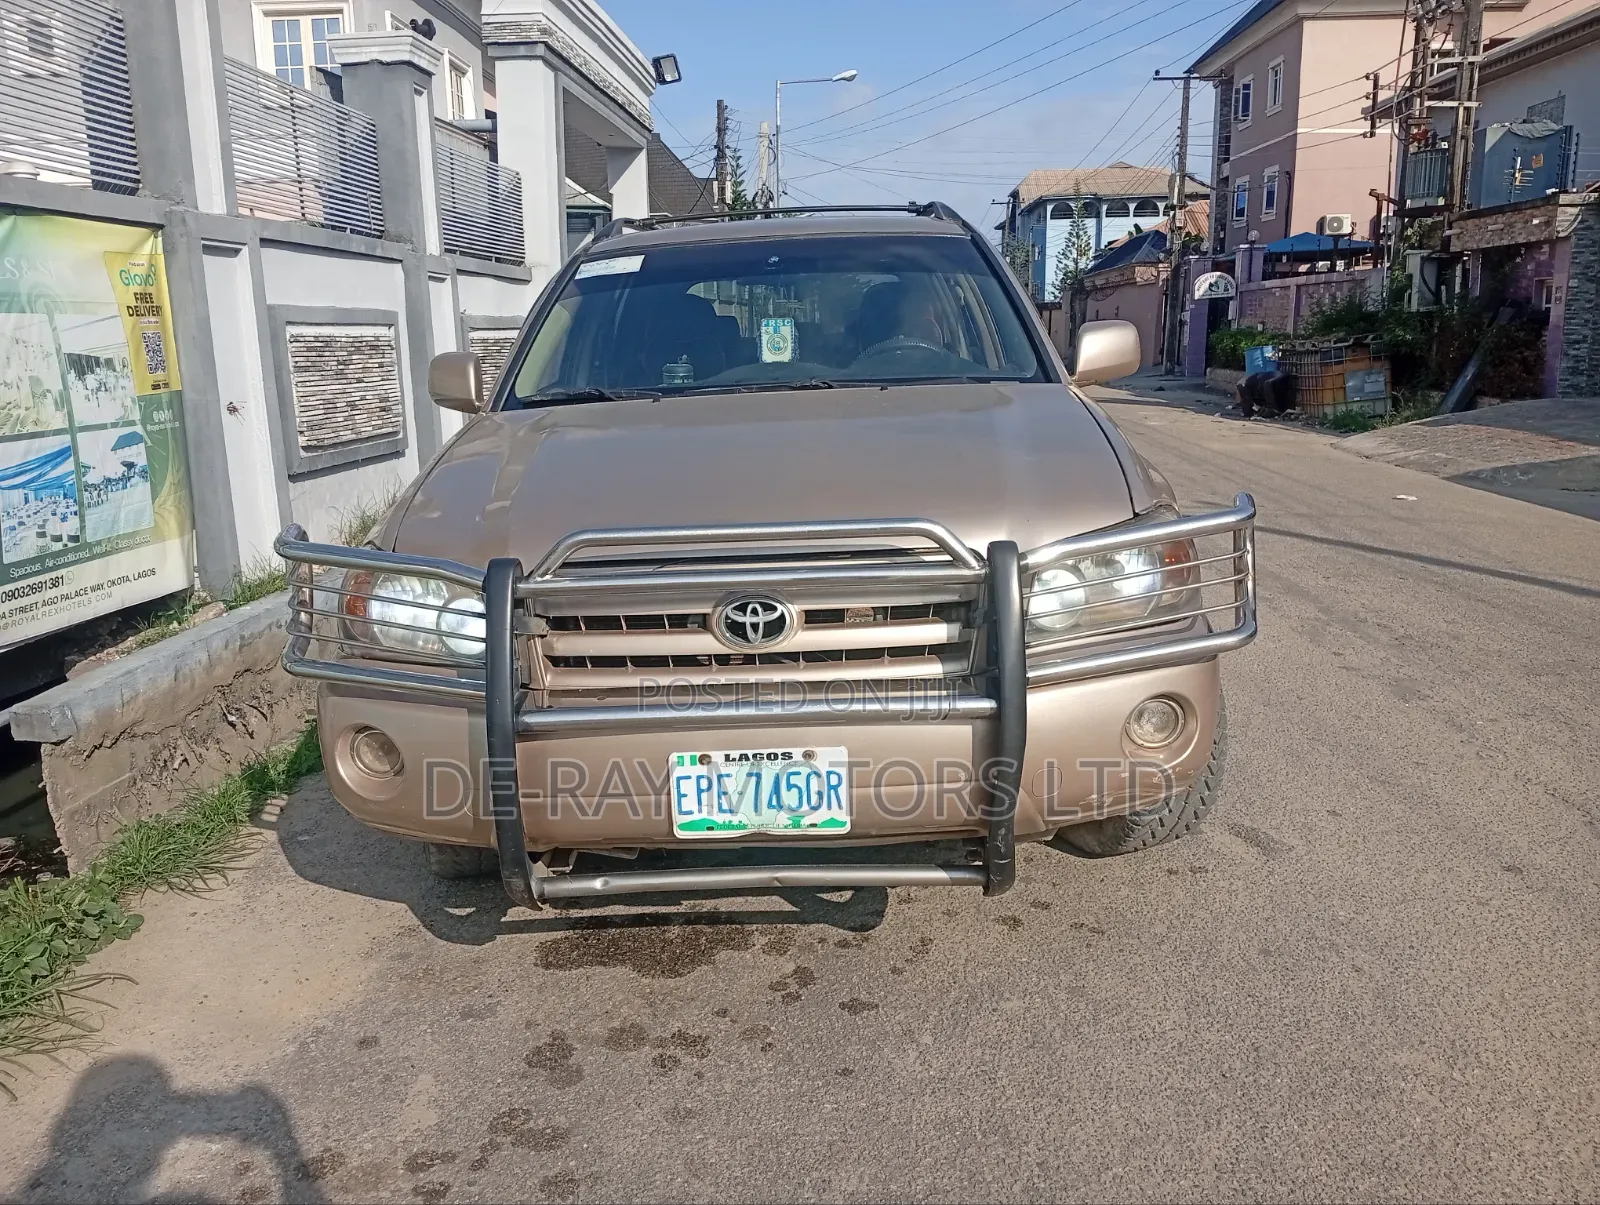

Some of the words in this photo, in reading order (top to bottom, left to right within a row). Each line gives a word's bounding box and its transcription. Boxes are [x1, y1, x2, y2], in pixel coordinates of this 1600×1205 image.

[119, 268, 155, 287] Glovo
[133, 292, 155, 304] FREE
[126, 305, 163, 317] DELIVERY
[9, 564, 42, 578] Spacious.
[1, 574, 64, 604] 09032691381
[8, 601, 40, 619] STREET,
[41, 596, 59, 609] AGO
[60, 586, 89, 602] PALACE
[90, 582, 106, 593] WAY,
[106, 575, 132, 589] OKOTA,
[132, 567, 157, 581] LAGOS
[724, 751, 794, 762] LAGOS
